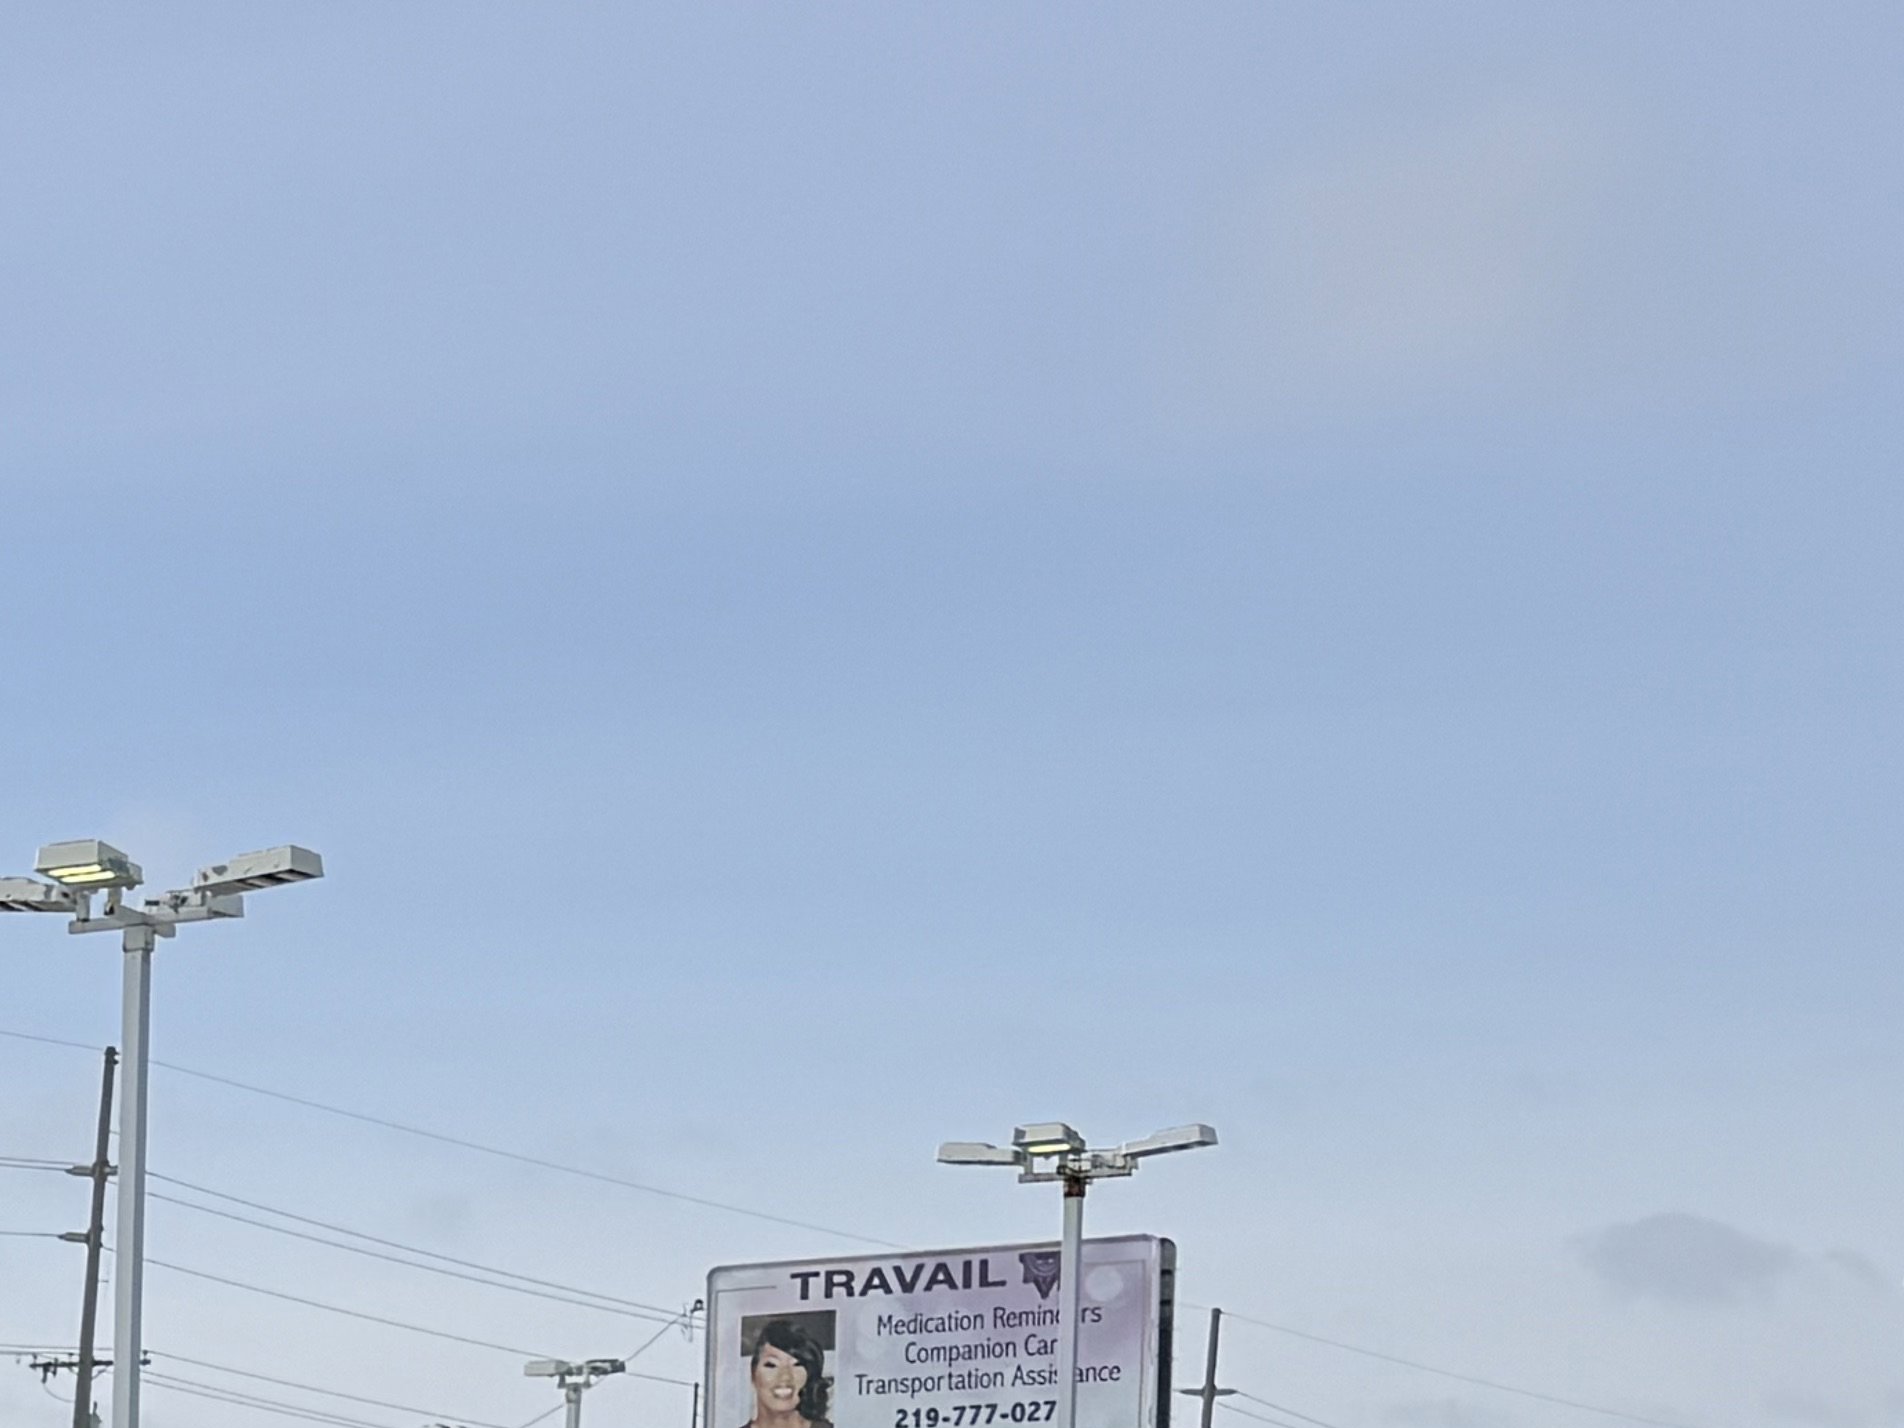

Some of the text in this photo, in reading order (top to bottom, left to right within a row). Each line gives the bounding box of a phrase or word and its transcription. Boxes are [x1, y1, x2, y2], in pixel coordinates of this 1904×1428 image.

[790, 1259, 1007, 1300] TRAVAIL
[877, 1304, 1102, 1336] Medication Reminrs
[905, 1334, 1059, 1367] Companion Car
[855, 1364, 1121, 1398] Transportation Assiance
[895, 1400, 1057, 1428] 219-777-027
